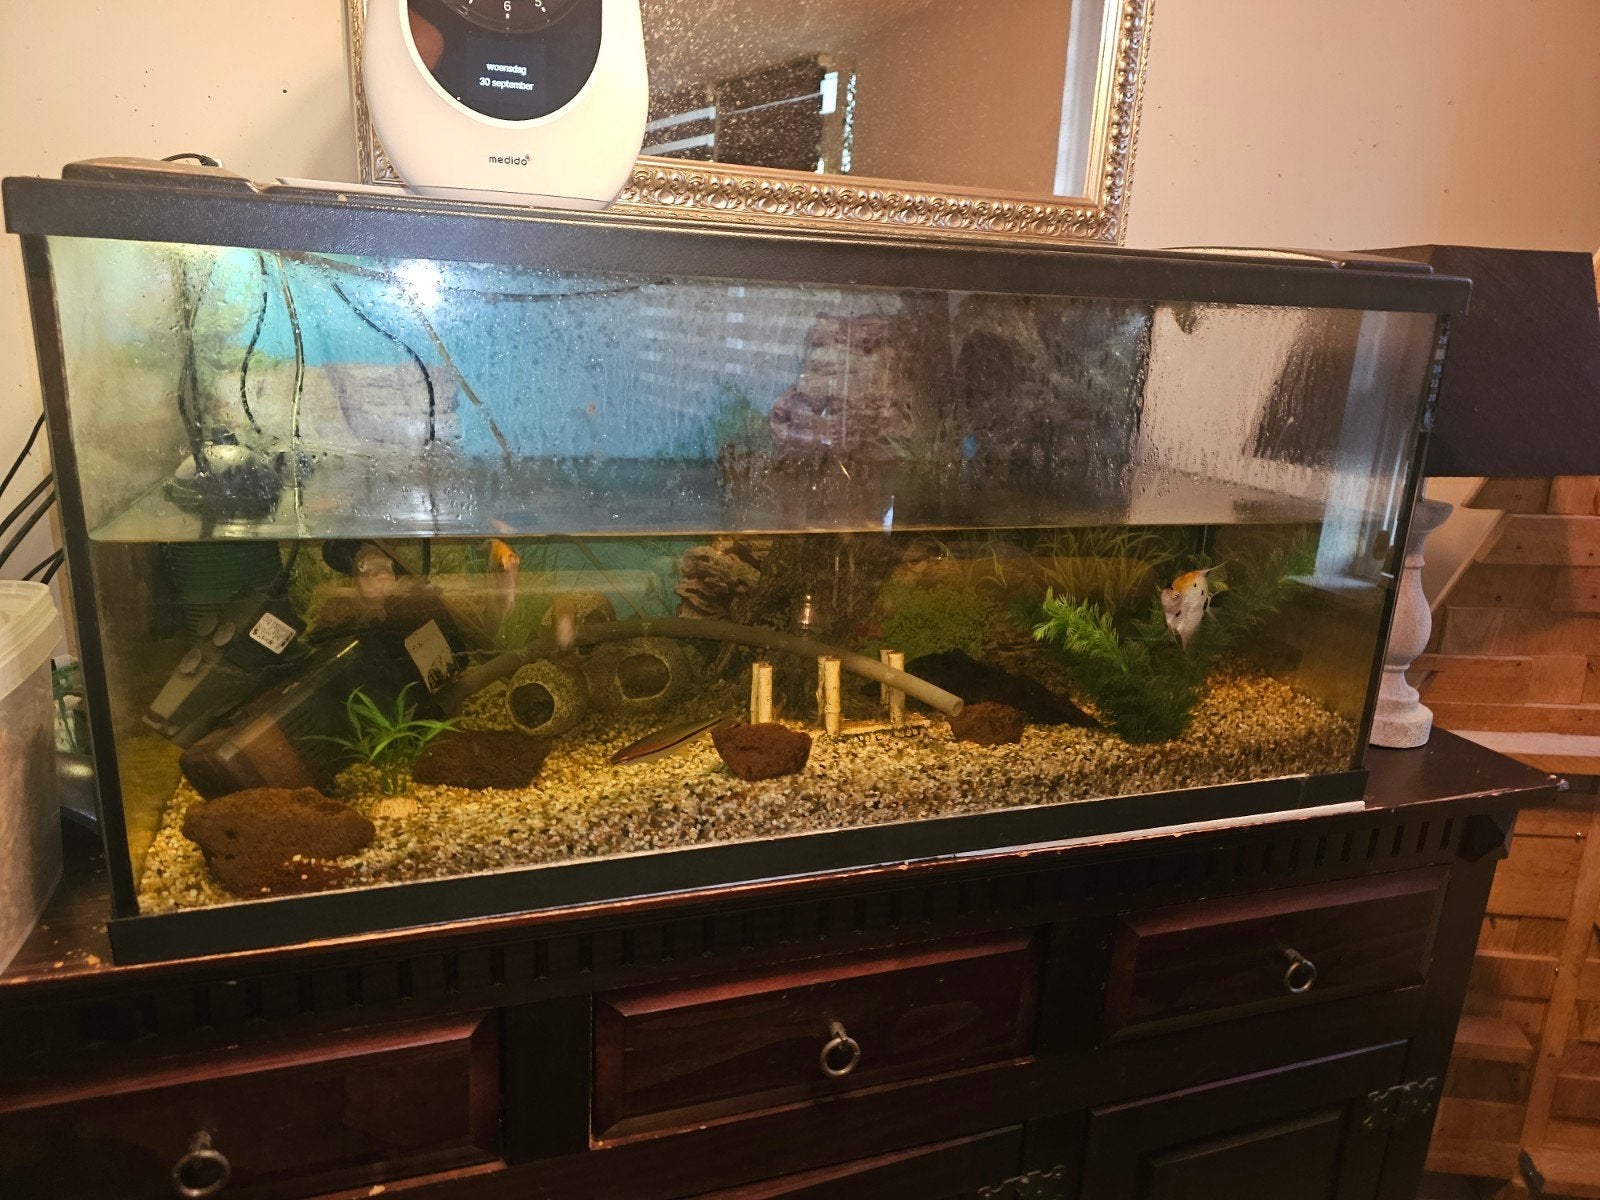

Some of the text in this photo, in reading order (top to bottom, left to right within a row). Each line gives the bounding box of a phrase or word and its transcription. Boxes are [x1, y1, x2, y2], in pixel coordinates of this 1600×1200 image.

[503, 0, 512, 12] 6
[486, 63, 527, 76] woensdag
[479, 76, 534, 91] 30 september
[488, 155, 528, 166] medido
